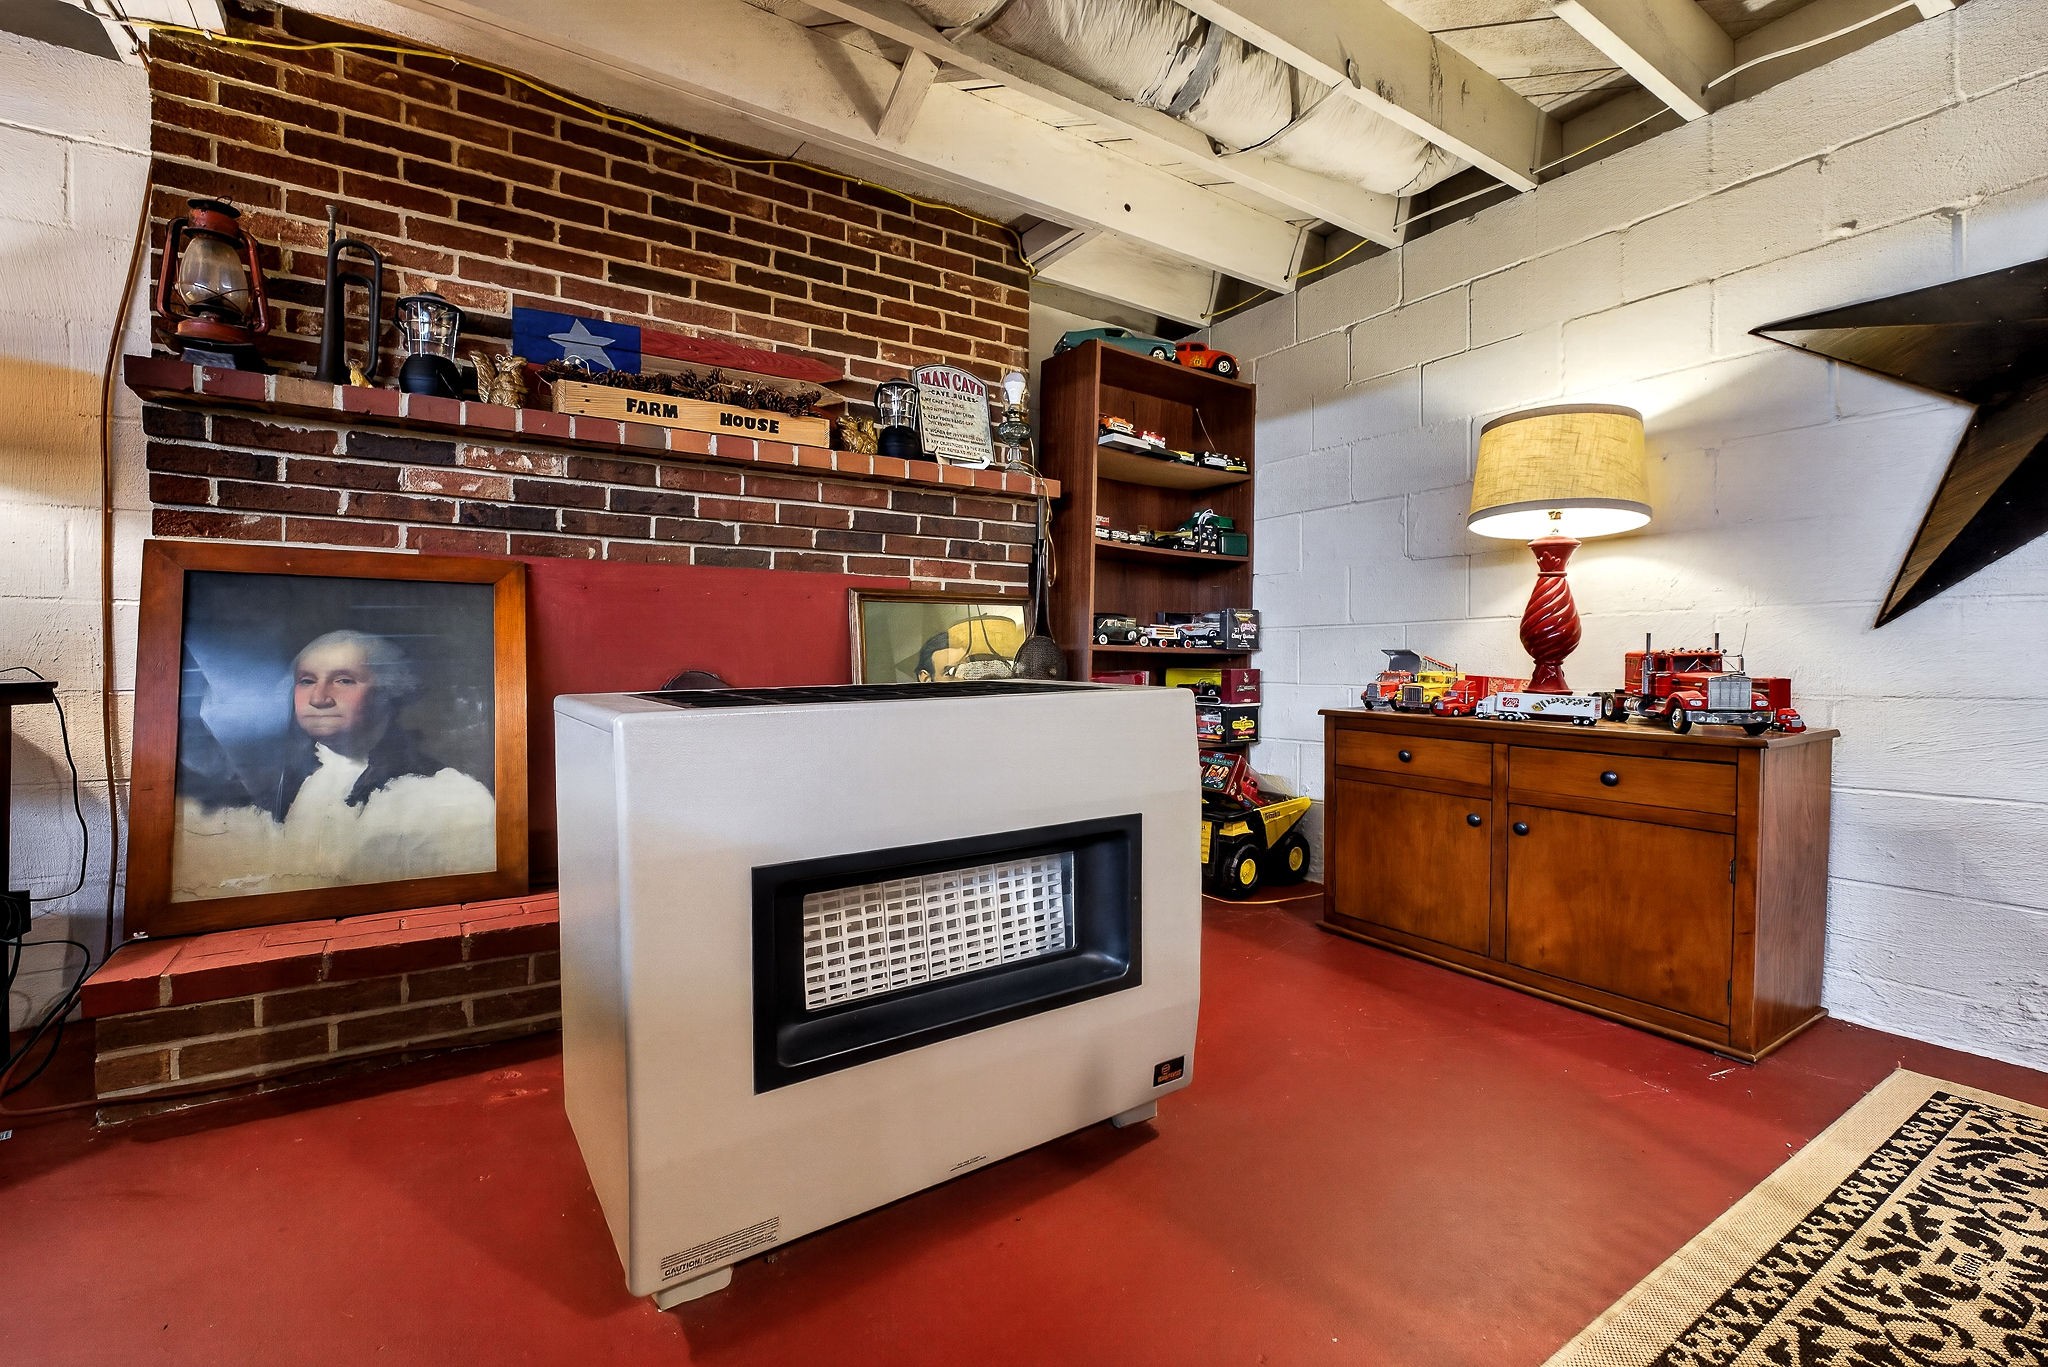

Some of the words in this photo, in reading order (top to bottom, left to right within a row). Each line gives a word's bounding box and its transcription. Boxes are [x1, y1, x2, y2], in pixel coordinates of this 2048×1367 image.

[920, 371, 950, 389] MAN
[952, 374, 984, 397] CAVE
[626, 397, 679, 419] FARM
[720, 412, 780, 434] HOUSE
